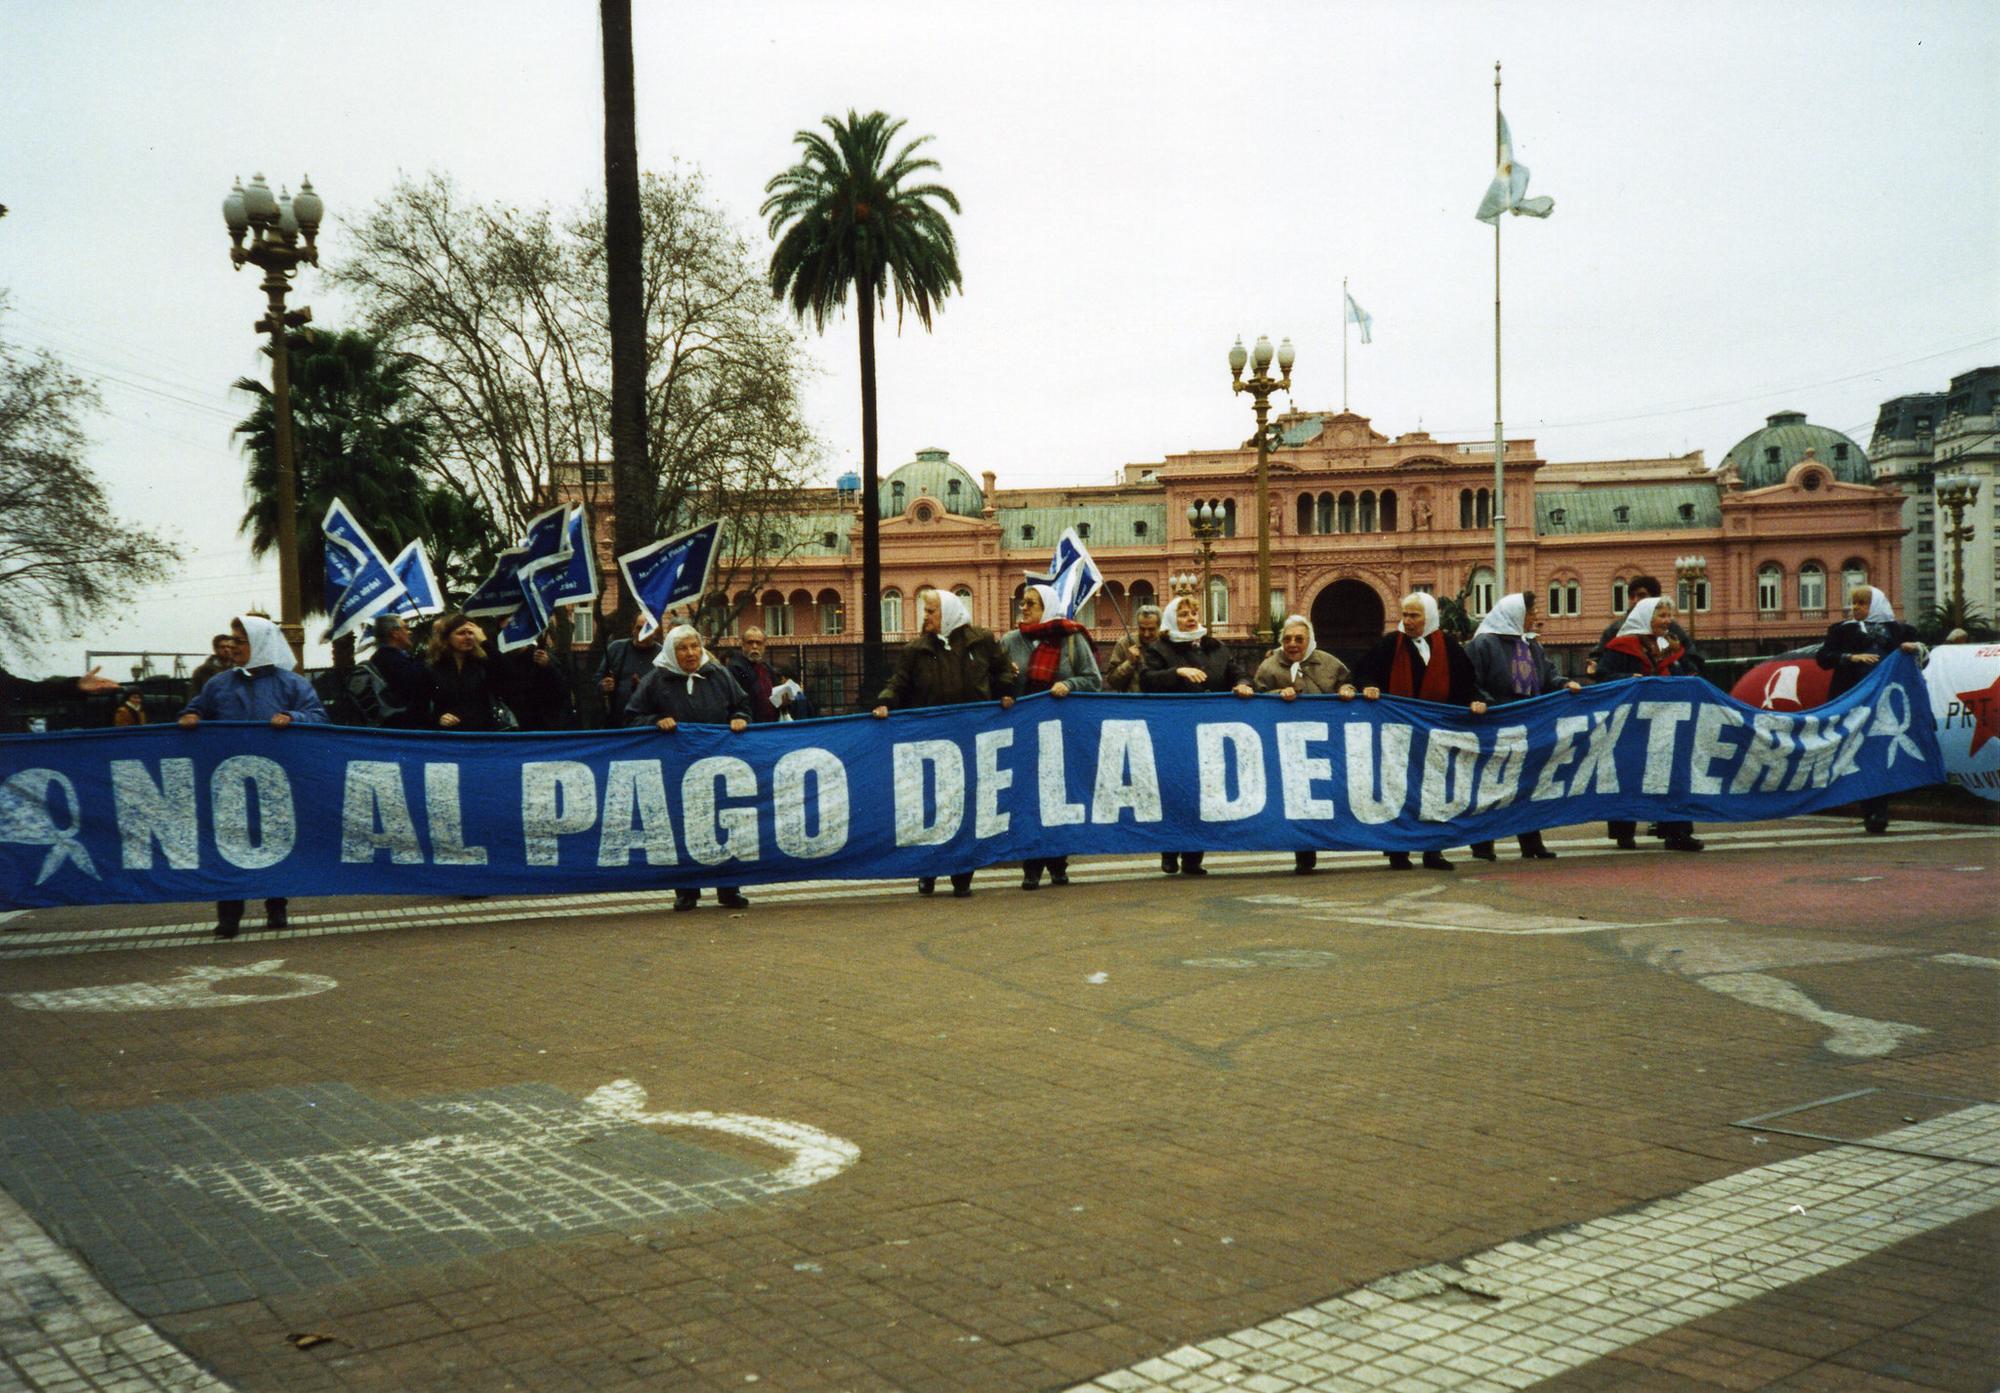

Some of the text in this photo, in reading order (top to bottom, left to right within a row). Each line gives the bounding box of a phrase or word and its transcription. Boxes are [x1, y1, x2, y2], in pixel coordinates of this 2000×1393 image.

[110, 701, 1871, 872] NO AL PAGO DE LA DEUDA EXTERNA
